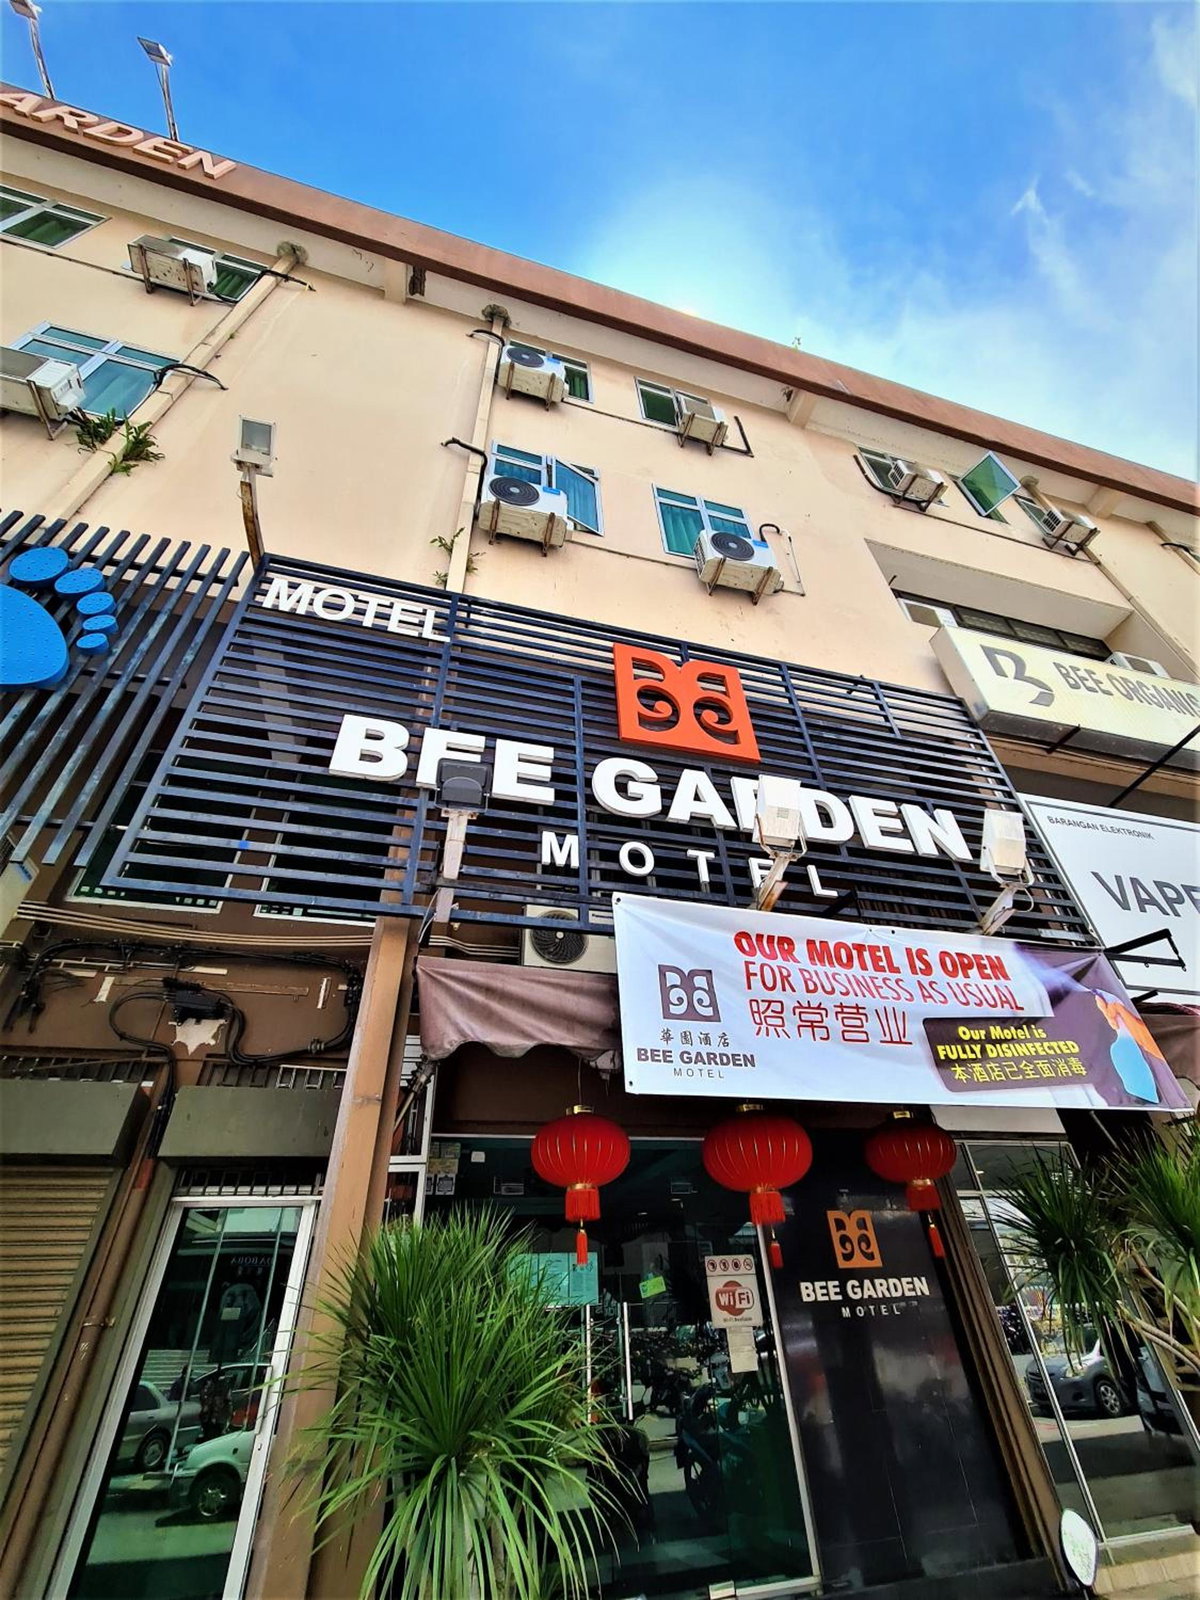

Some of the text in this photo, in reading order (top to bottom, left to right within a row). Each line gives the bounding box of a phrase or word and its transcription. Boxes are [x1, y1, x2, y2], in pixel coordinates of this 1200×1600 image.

[261, 577, 451, 642] MOTEL
[1053, 662, 1114, 696] BEE
[1047, 815, 1155, 840] BARANGAN ELEKTRONIK
[541, 830, 838, 898] MOTEL
[733, 931, 1011, 981] OUR MOTEL IS OPEN
[744, 961, 1024, 1011] FOR BUSINESS AS USUAL
[750, 999, 913, 1045] 照常营业
[958, 1025, 1047, 1040] Our Motel is
[637, 1047, 755, 1067] BEE GARDEN
[937, 1041, 1080, 1059] FULLY DISINFECTED
[673, 1067, 724, 1079] MOTEL
[951, 1057, 1087, 1083] 本酒店已全面消毒
[800, 1276, 930, 1302] BEE GARDEN
[842, 1304, 900, 1317] MOTEL
